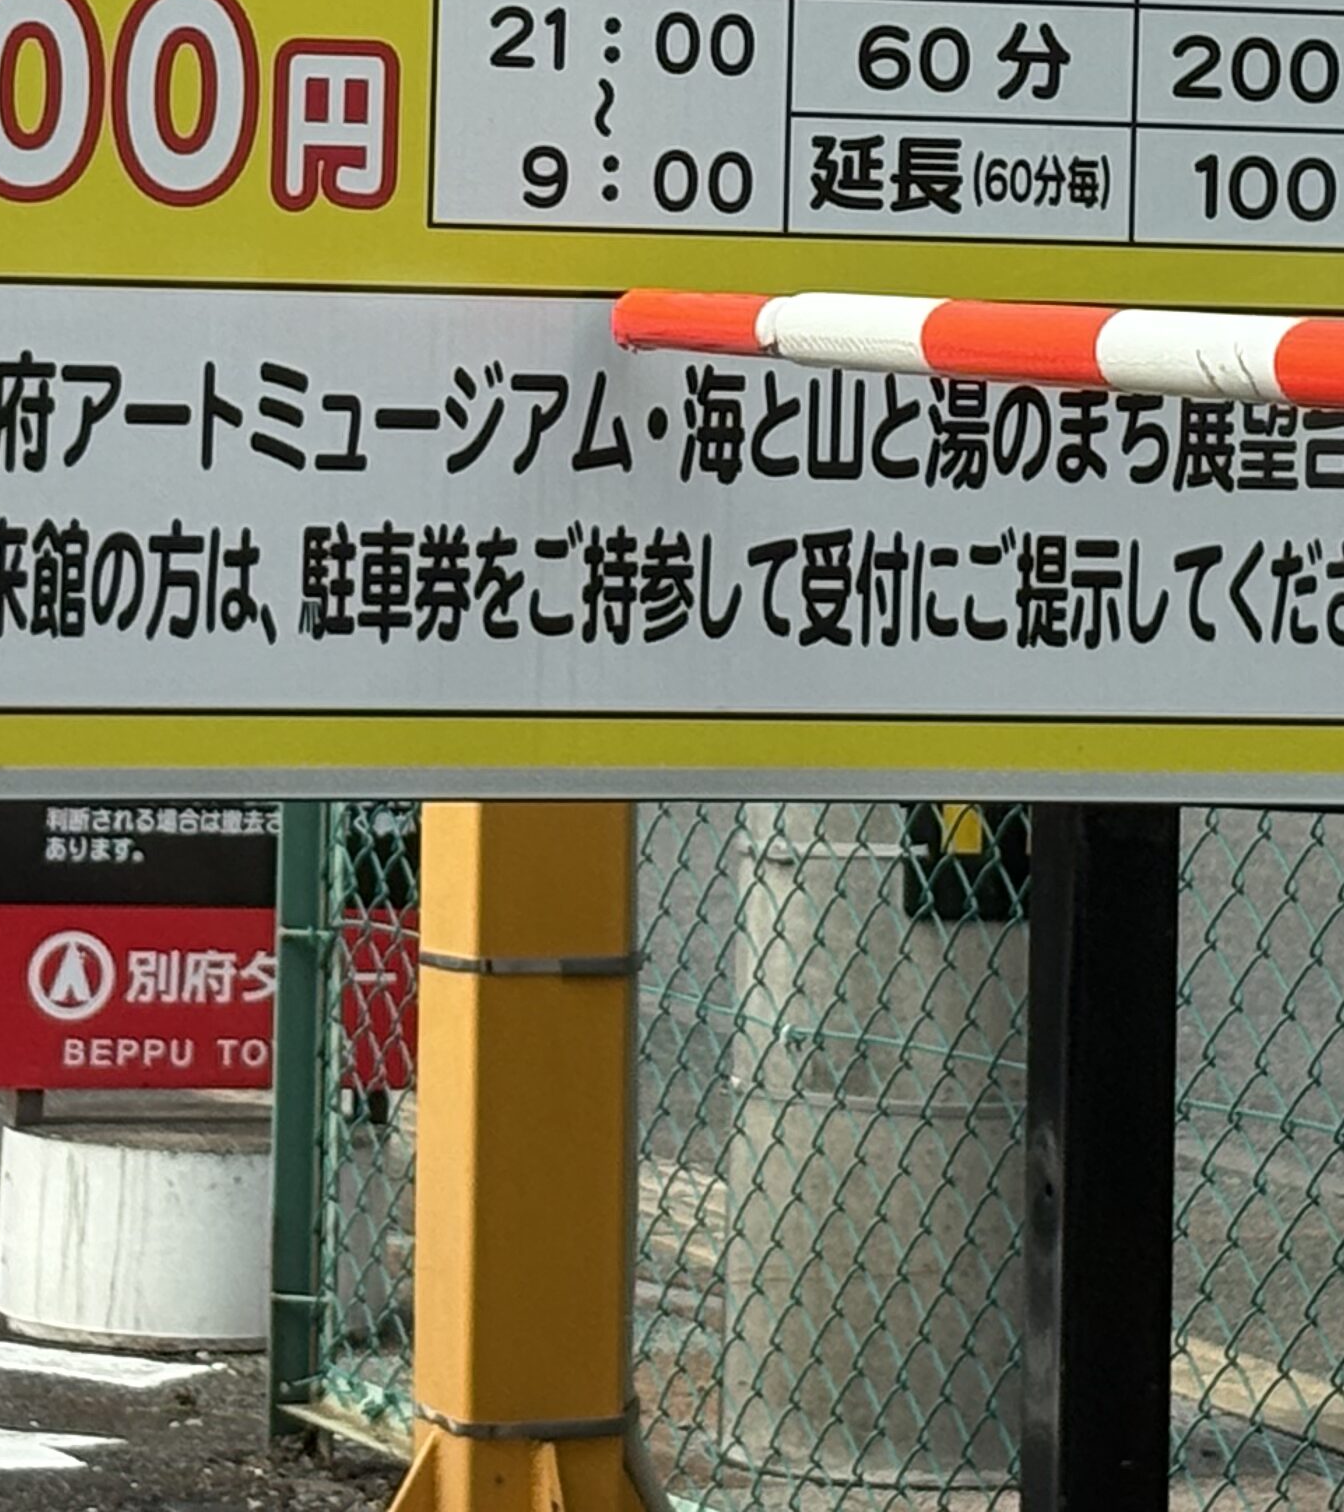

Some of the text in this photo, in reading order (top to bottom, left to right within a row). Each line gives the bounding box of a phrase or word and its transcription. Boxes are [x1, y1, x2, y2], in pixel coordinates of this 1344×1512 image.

[44, 838, 146, 864] あります。
[63, 1038, 275, 1069] BEPPU TO
